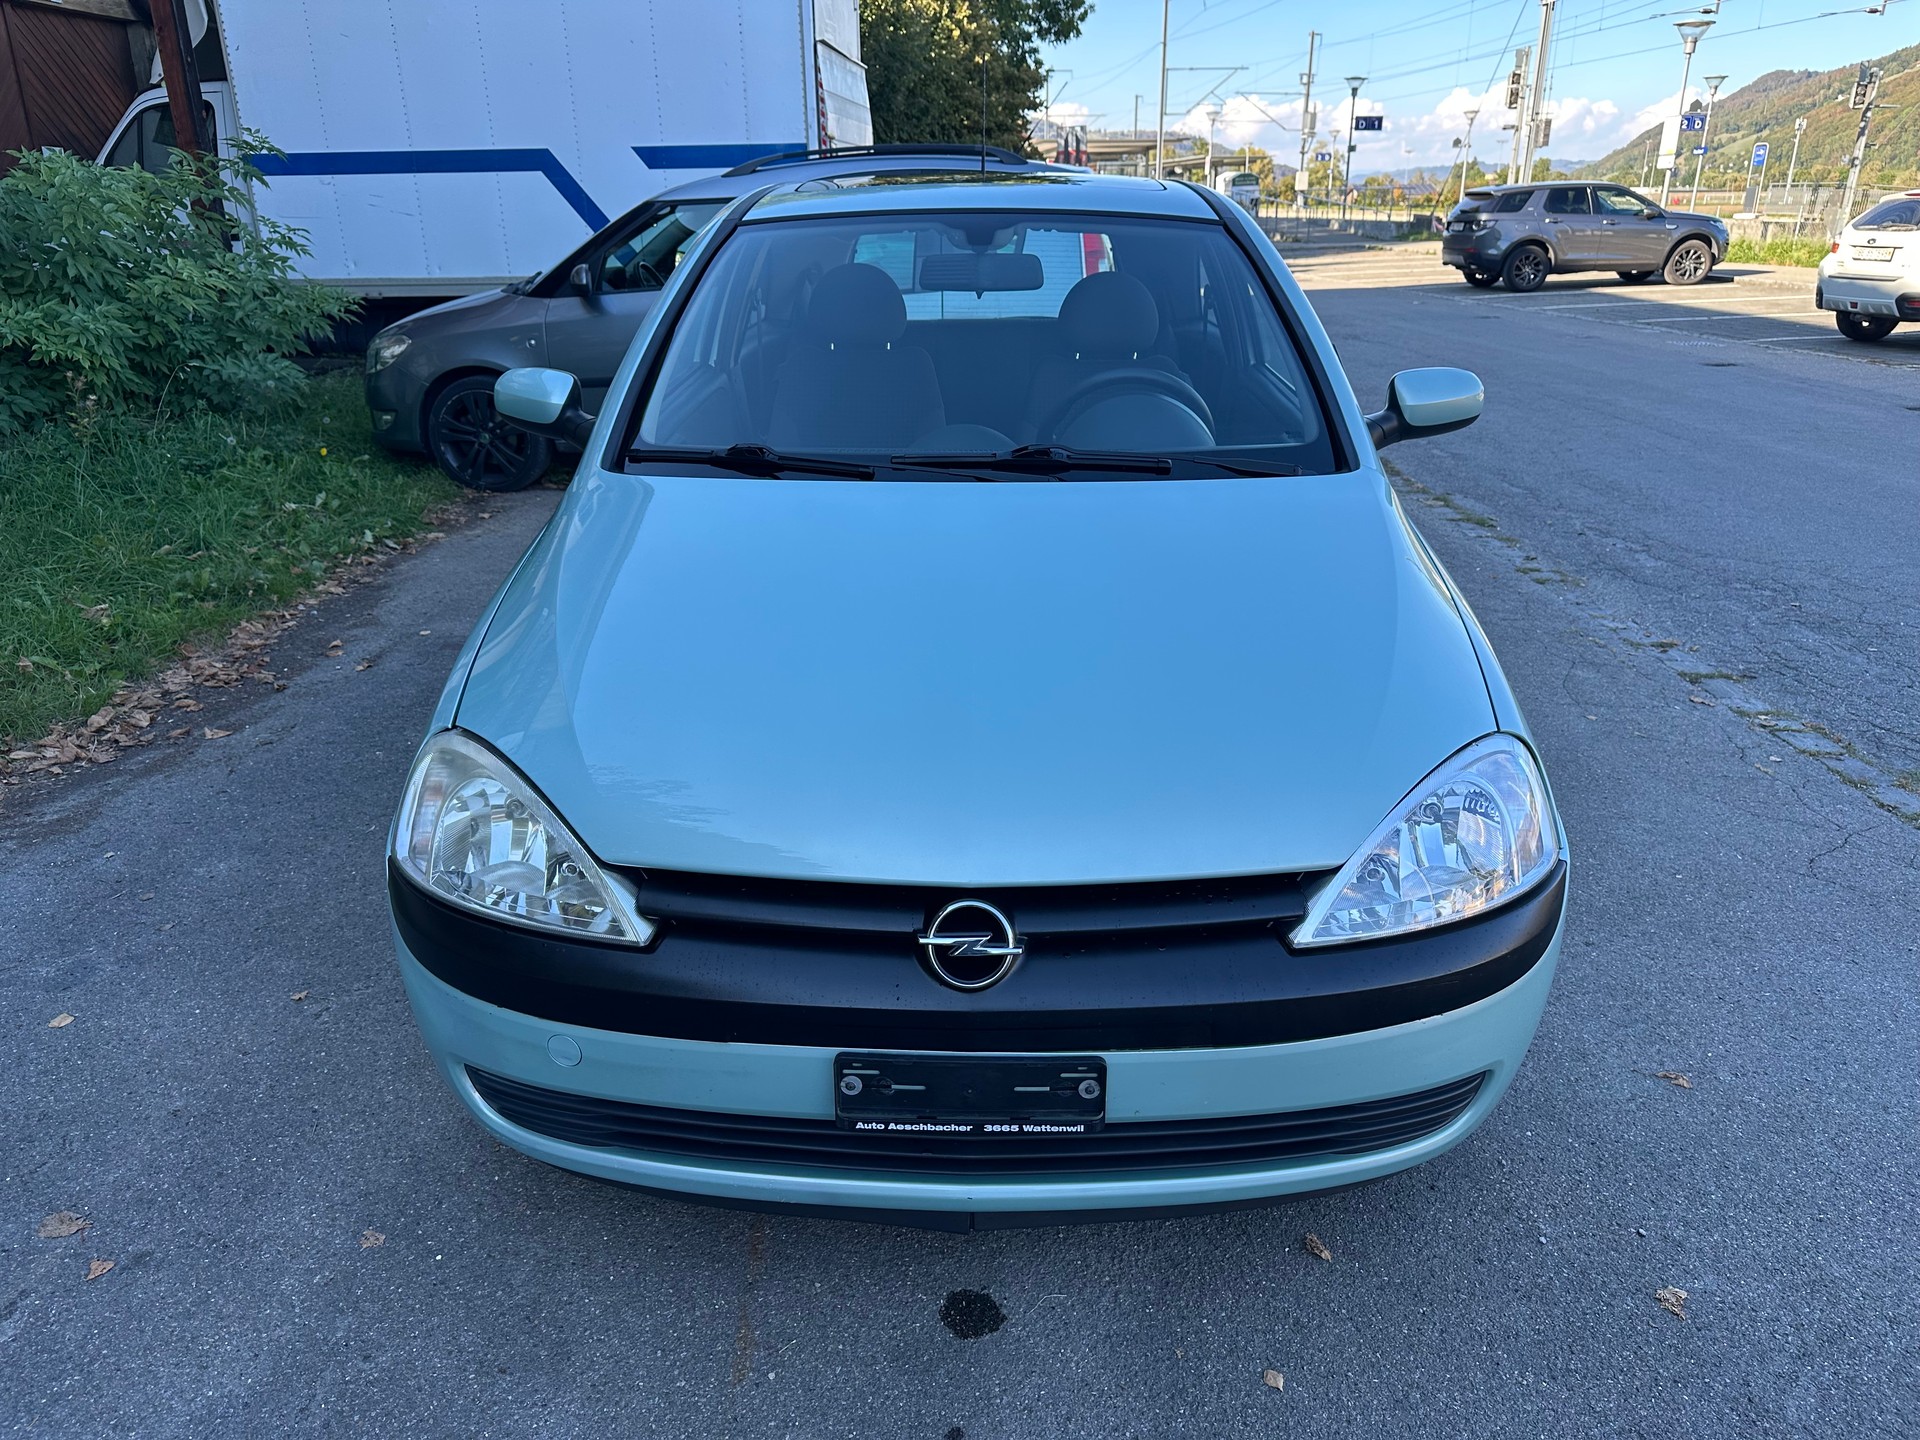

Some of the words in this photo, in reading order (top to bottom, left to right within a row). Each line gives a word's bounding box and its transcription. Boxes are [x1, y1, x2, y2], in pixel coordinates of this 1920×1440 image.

[1358, 120, 1366, 129] D
[1374, 120, 1379, 129] 1
[1681, 120, 1688, 129] 2
[1694, 120, 1702, 129] D
[855, 1121, 885, 1130] Auto
[888, 1122, 974, 1132] Aeschbacher
[983, 1124, 1020, 1132] 3665
[1022, 1124, 1085, 1132] Wattenwil
